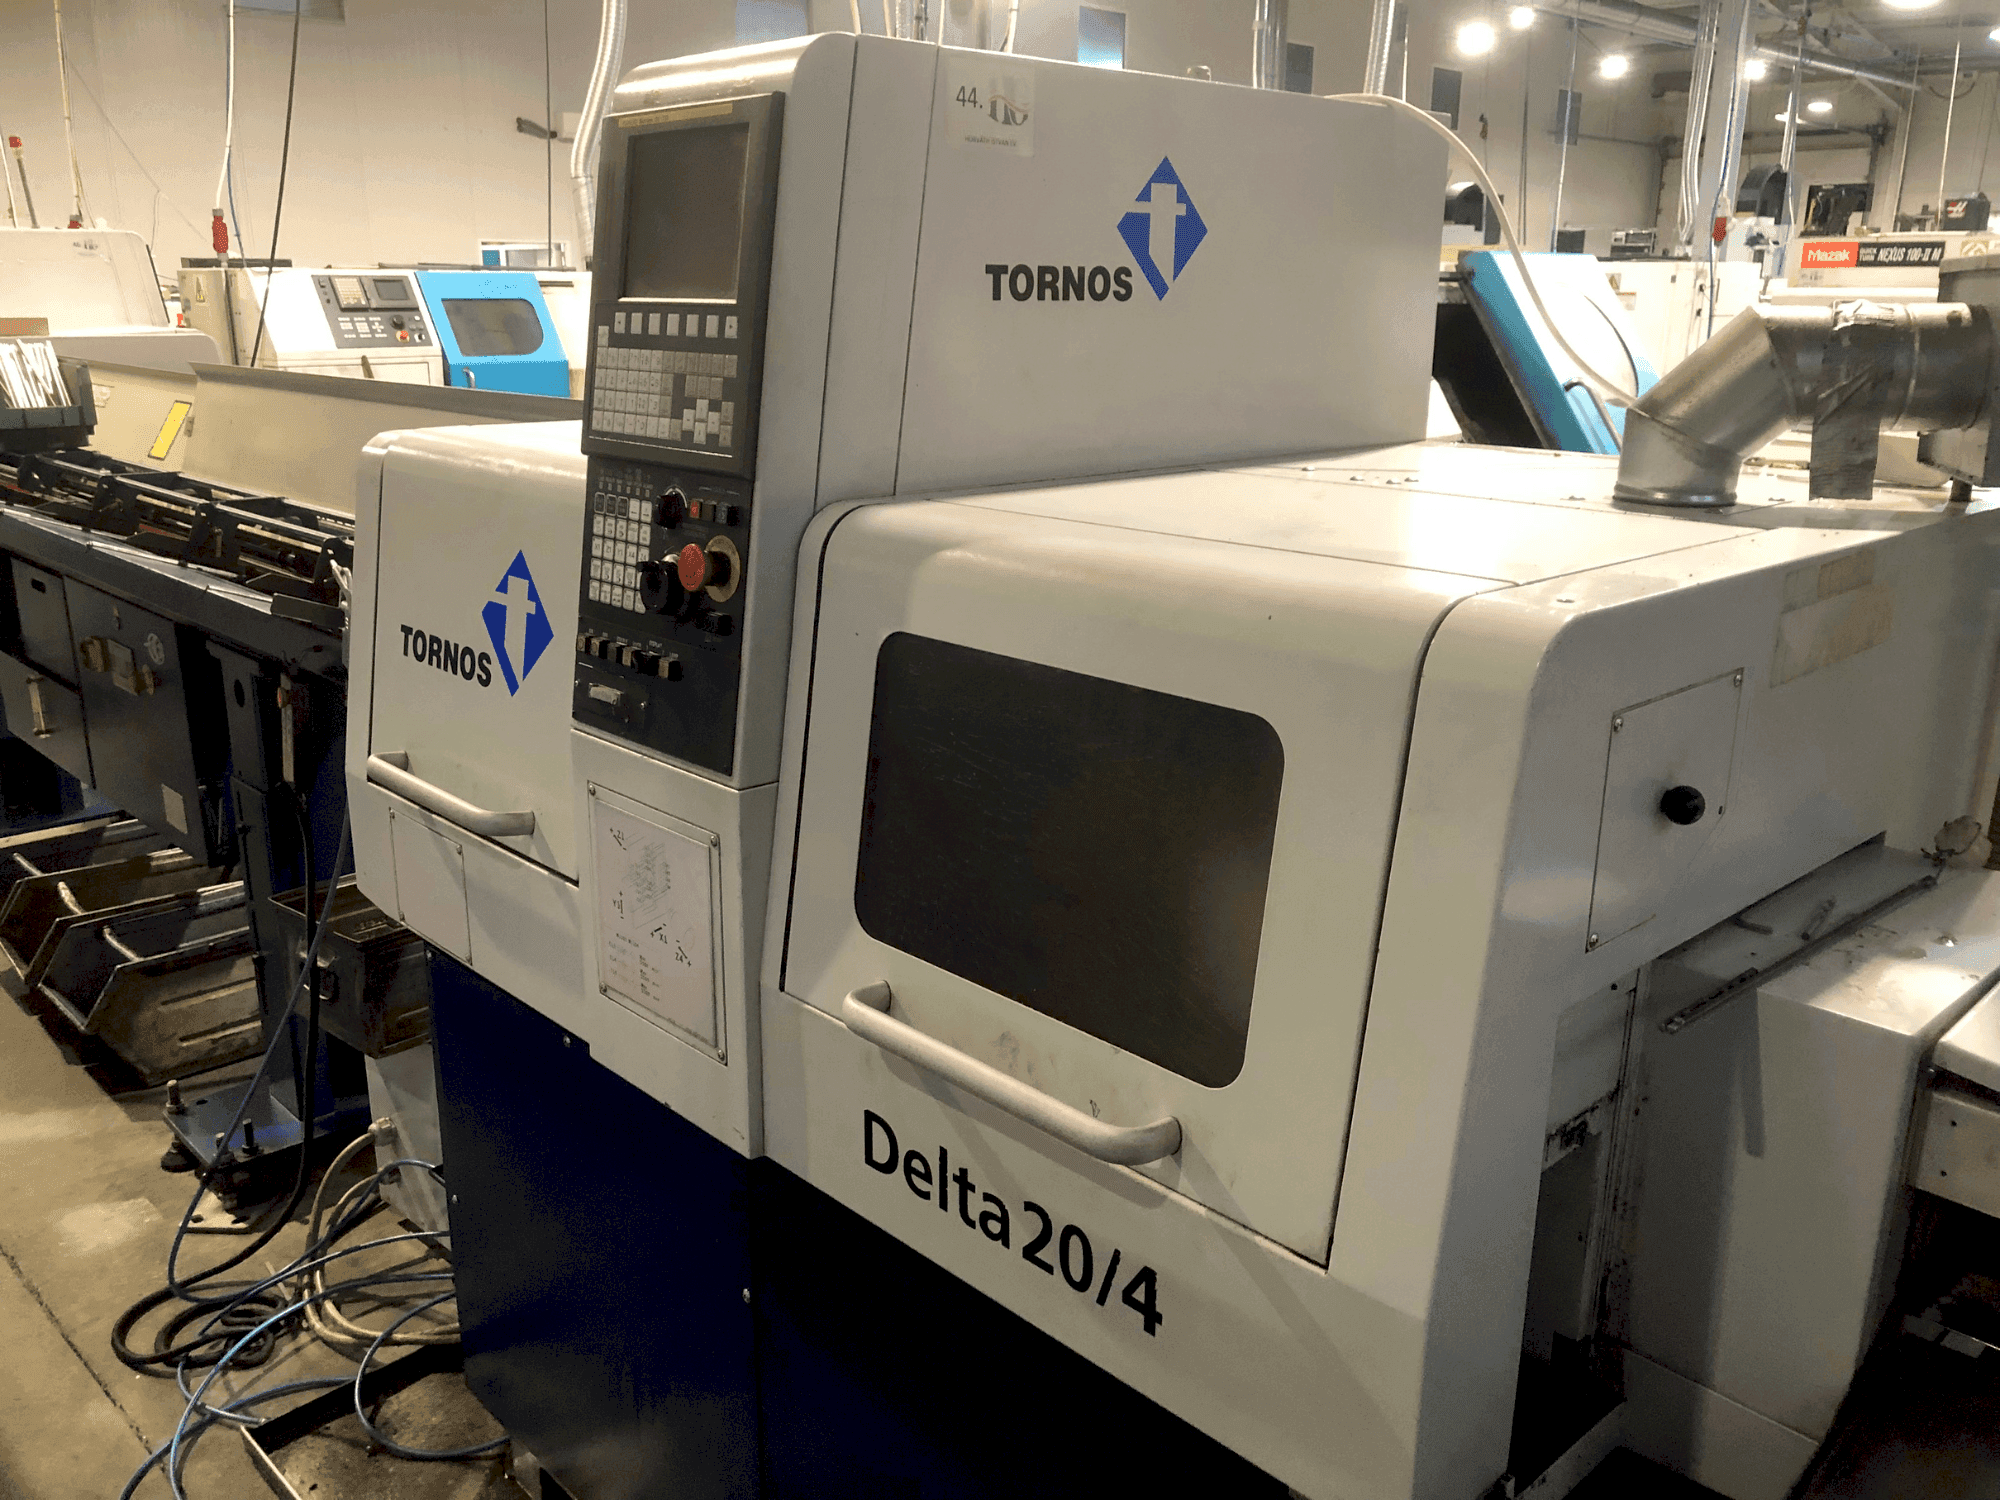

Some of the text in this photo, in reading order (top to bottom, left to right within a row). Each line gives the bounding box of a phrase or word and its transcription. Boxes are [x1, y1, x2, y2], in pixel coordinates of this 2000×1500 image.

[956, 85, 983, 109] 44.
[1808, 249, 1851, 262] Mazak
[1877, 246, 1906, 263] NEXUS
[1931, 247, 1942, 262] M
[985, 263, 1133, 302] TORNOS
[400, 623, 492, 688] TORNOS
